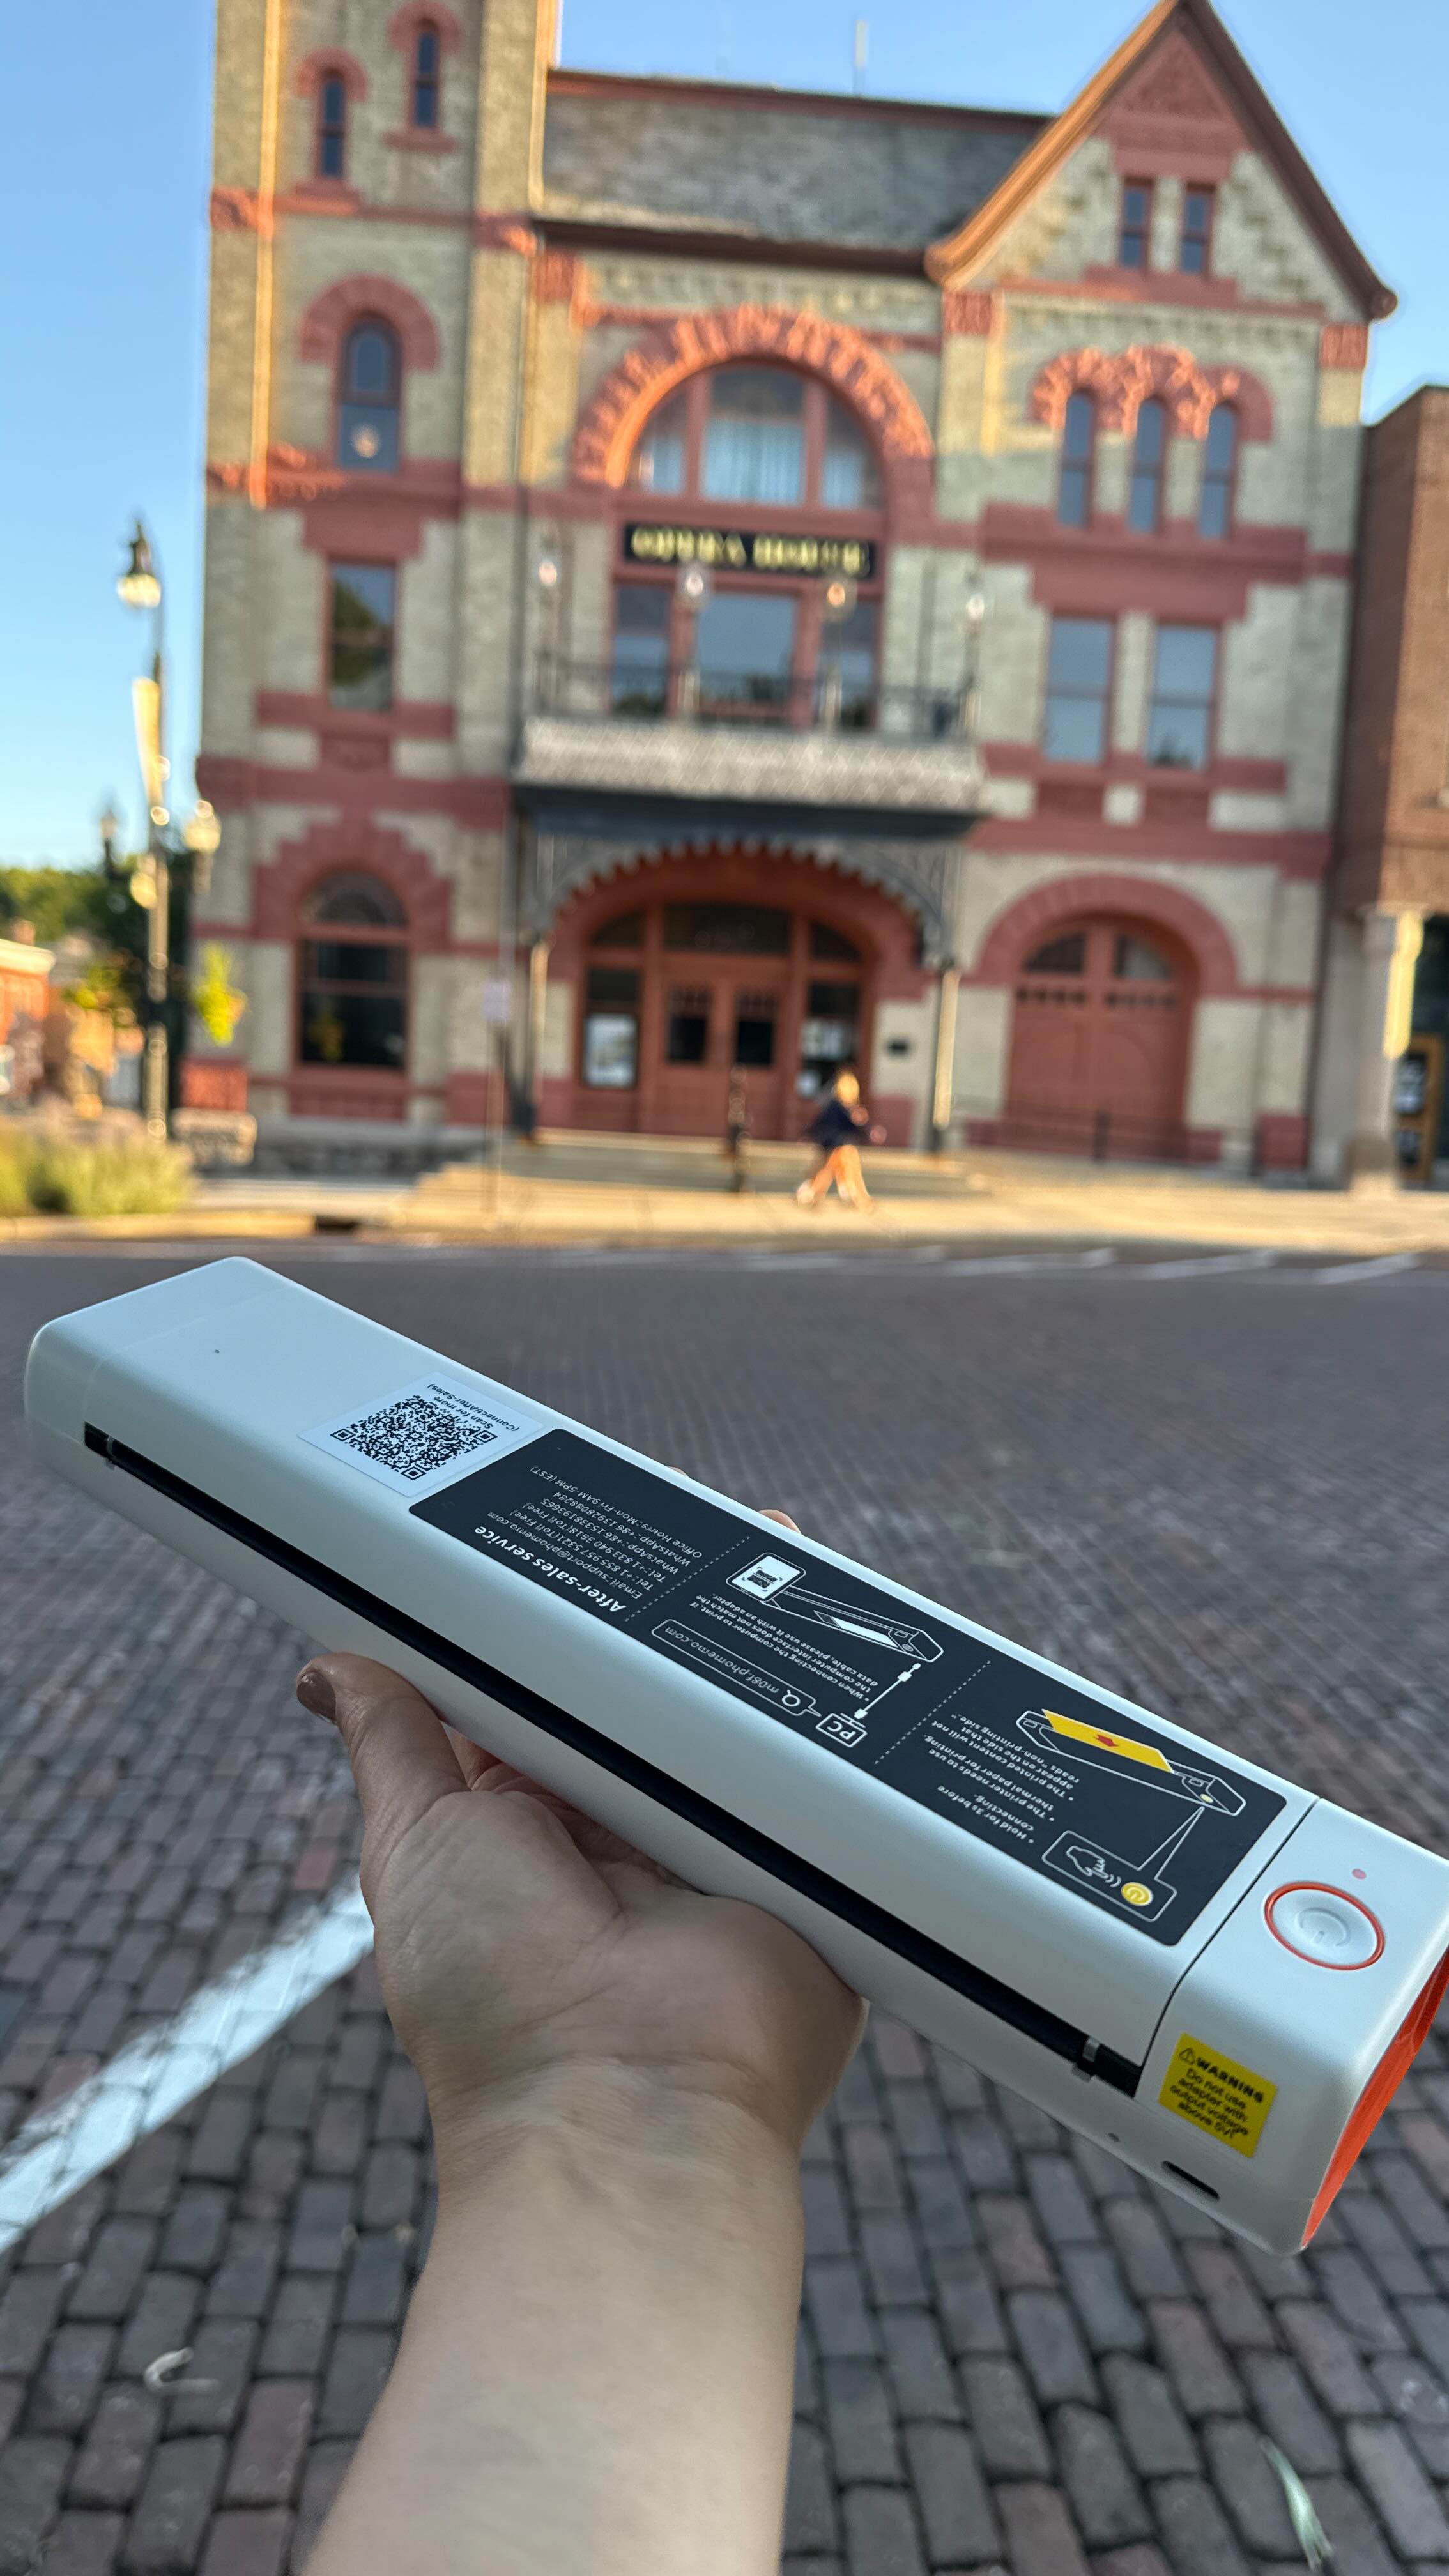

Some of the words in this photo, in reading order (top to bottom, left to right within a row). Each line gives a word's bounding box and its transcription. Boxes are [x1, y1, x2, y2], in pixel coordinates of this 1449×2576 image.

[427, 1383, 520, 1432] (Connect/After-Sales)
[433, 1396, 457, 1409] more
[456, 1408, 471, 1417] for
[470, 1415, 494, 1429] Scan
[530, 1466, 558, 1482] (EST)
[555, 1480, 601, 1505] 9AM-5PM
[509, 1510, 537, 1526] Free)
[522, 1503, 550, 1519] Free)
[540, 1499, 606, 1535] 15338193665
[474, 1526, 535, 1560] service
[593, 1540, 615, 1554] 940
[672, 1540, 703, 1558] Office
[579, 1549, 602, 1561] 957
[612, 1551, 634, 1564] 833
[599, 1559, 621, 1572] 855
[532, 1558, 627, 1612] After-sales
[696, 1595, 711, 1605] the
[712, 1593, 746, 1614] adapter.
[701, 1605, 724, 1620] print,
[710, 1602, 737, 1618] match
[736, 1616, 752, 1627] not
[756, 1618, 777, 1631] with
[732, 1624, 774, 1648] computer
[751, 1625, 773, 1638] does
[784, 1634, 801, 1644] use
[772, 1636, 812, 1660] interface
[773, 1646, 789, 1657] the
[800, 1642, 831, 1660] please
[664, 1627, 779, 1694] m08f.phomemo.com
[788, 1653, 838, 1683] connecting
[831, 1657, 857, 1675] cable,
[811, 1659, 860, 1686] computer
[857, 1673, 878, 1686] data
[838, 1682, 864, 1699] When
[855, 1682, 871, 1692] the
[827, 1721, 856, 1740] PC
[931, 1720, 950, 1732] not
[961, 1726, 983, 1741] that
[948, 1729, 969, 1743] will
[924, 1735, 967, 1761] printing.
[968, 1740, 1008, 1764] content
[983, 1738, 1004, 1752] side
[928, 1749, 947, 1761] use
[1004, 1750, 1022, 1763] the
[947, 1759, 958, 1768] to
[965, 1759, 981, 1771] for
[1022, 1759, 1036, 1769] on
[959, 1765, 990, 1785] needs
[981, 1768, 1013, 1787] paper
[1006, 1762, 1047, 1785] printed
[1036, 1768, 1073, 1790] appear
[1050, 1765, 1080, 1783] reads
[937, 1786, 972, 1808] before
[988, 1784, 1027, 1805] printer
[1010, 1784, 1054, 1811] thermal
[1046, 1783, 1066, 1798] The
[972, 1804, 985, 1815] 3s
[974, 1795, 1034, 1831] connecting.
[1027, 1804, 1046, 1818] The
[984, 1813, 1001, 1825] for
[999, 1821, 1027, 1839] Hold
[1197, 2057, 1263, 2103] WARNING
[1186, 2067, 1203, 2084] Do
[1204, 2081, 1223, 2096] not
[1225, 2093, 1246, 2110] use
[1179, 2078, 1222, 2106] adapter
[1224, 2106, 1248, 2122] with
[1170, 2085, 1206, 2108] output
[1208, 2107, 1248, 2136] voltage
[1179, 2101, 1212, 2126] above
